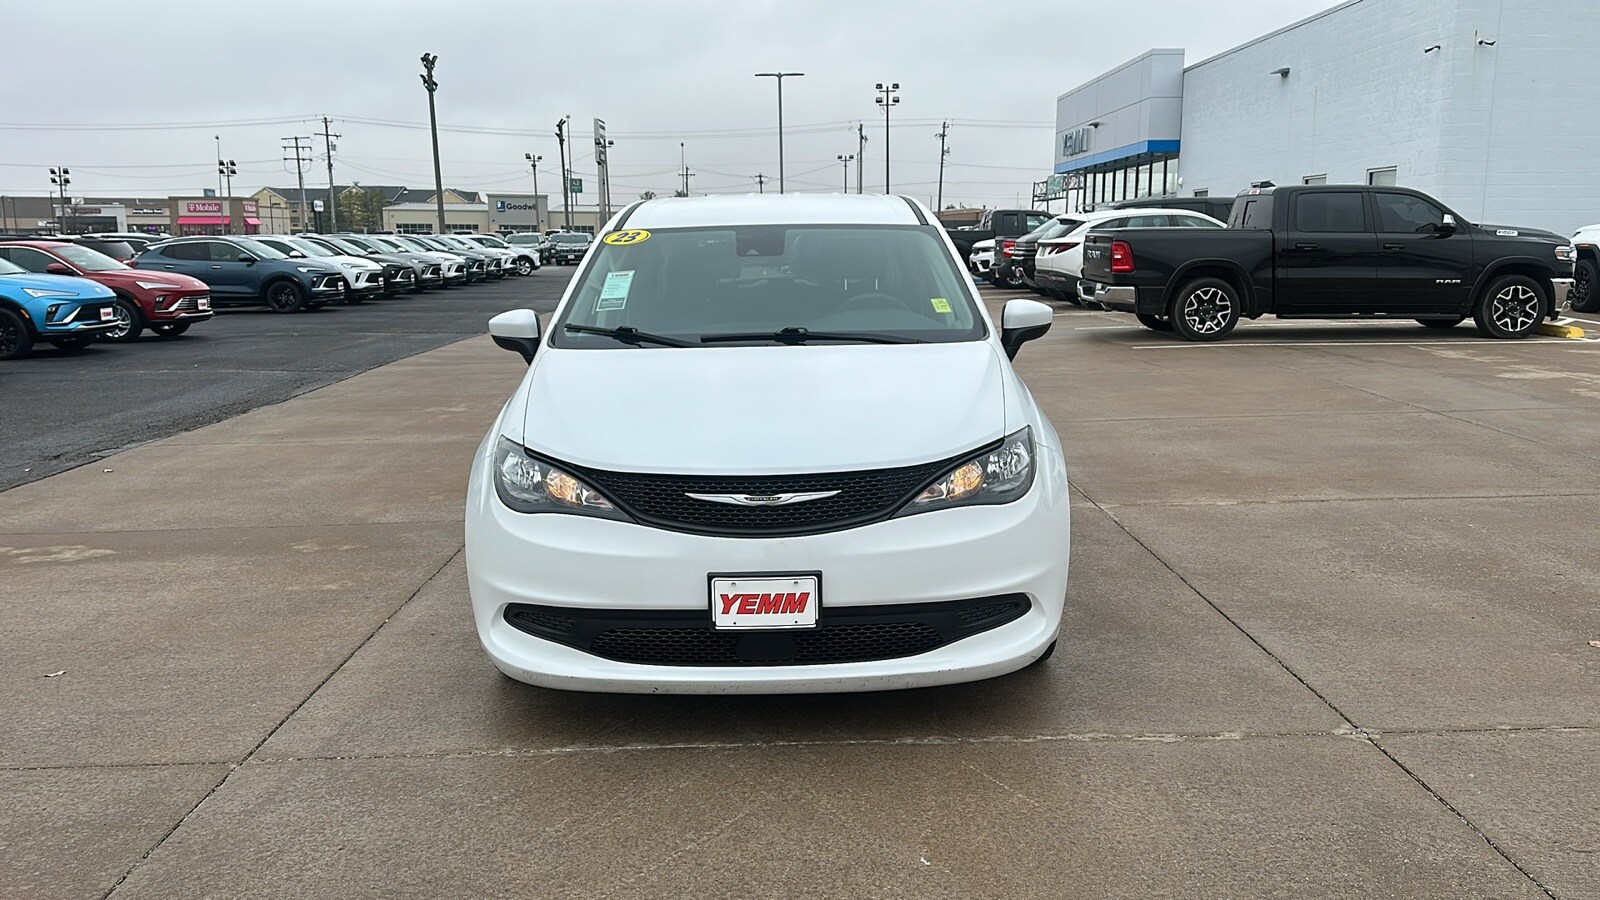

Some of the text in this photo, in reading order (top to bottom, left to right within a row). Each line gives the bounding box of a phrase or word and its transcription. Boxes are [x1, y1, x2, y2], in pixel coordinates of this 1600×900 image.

[611, 231, 640, 243] 23
[1087, 250, 1101, 259] RAM
[720, 592, 810, 615] YEMM
